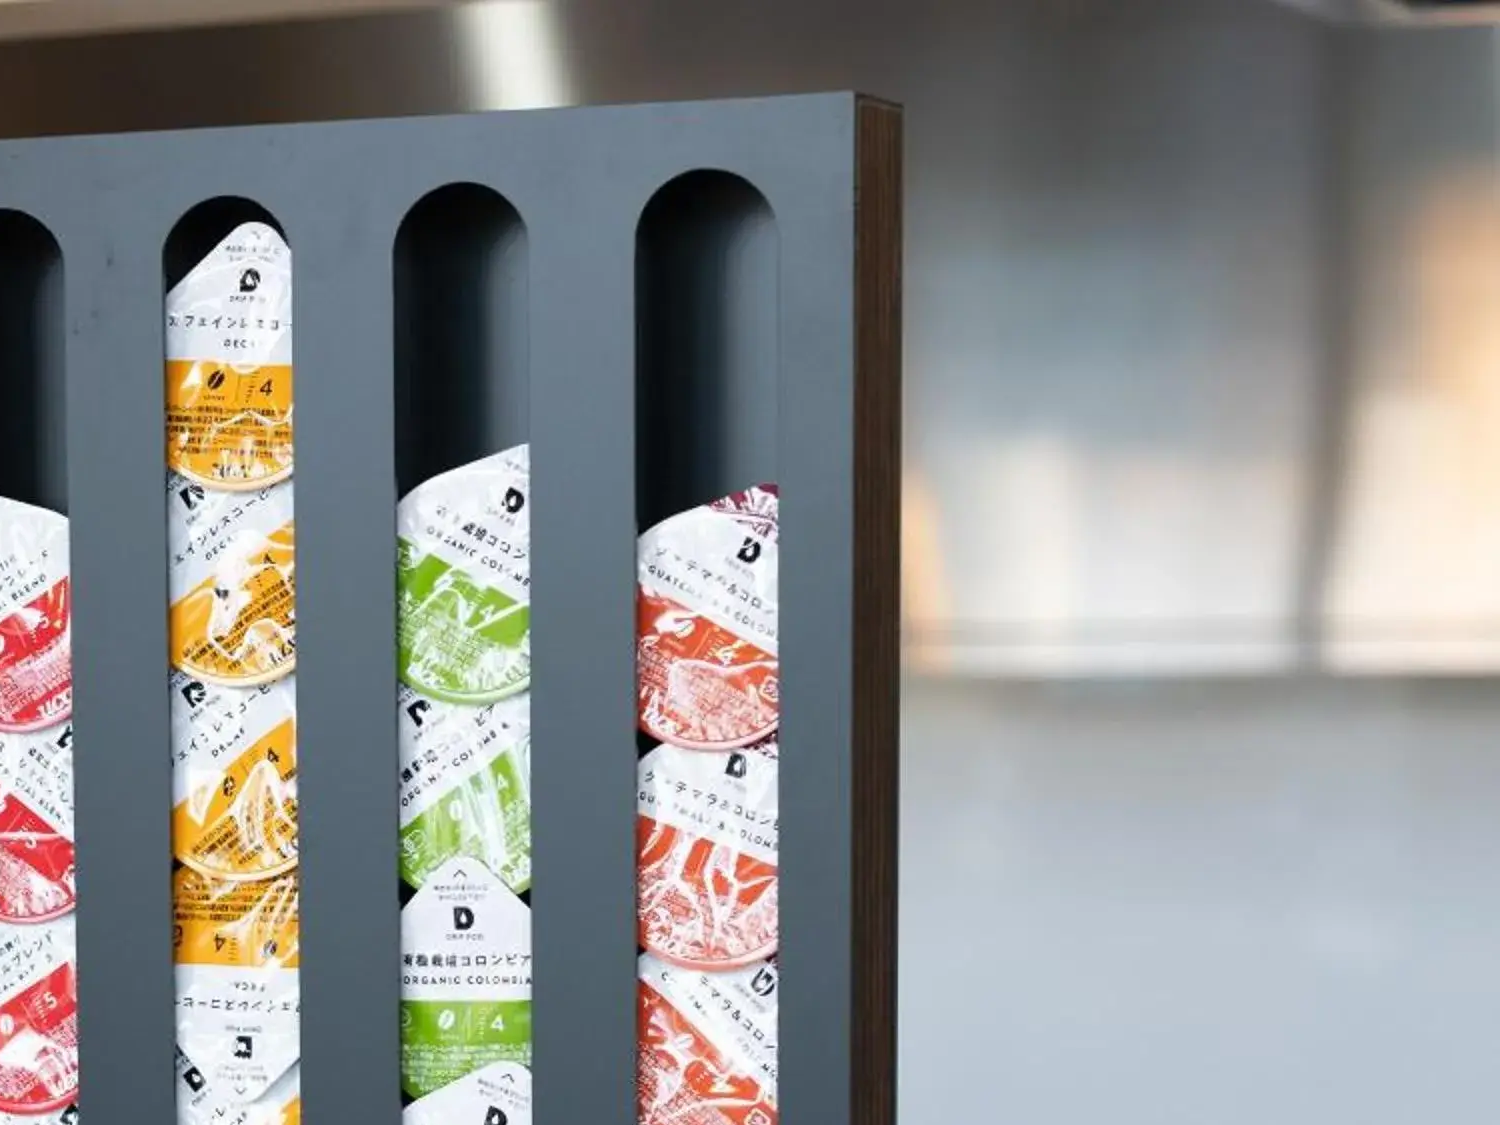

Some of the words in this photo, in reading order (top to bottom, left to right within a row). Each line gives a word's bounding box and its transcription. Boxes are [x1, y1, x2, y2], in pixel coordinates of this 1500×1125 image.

[259, 380, 273, 397] 4
[11, 573, 48, 601] BLEND
[403, 975, 462, 986] ORGANIC
[467, 975, 532, 986] COLOMBIA
[490, 1013, 505, 1032] 4
